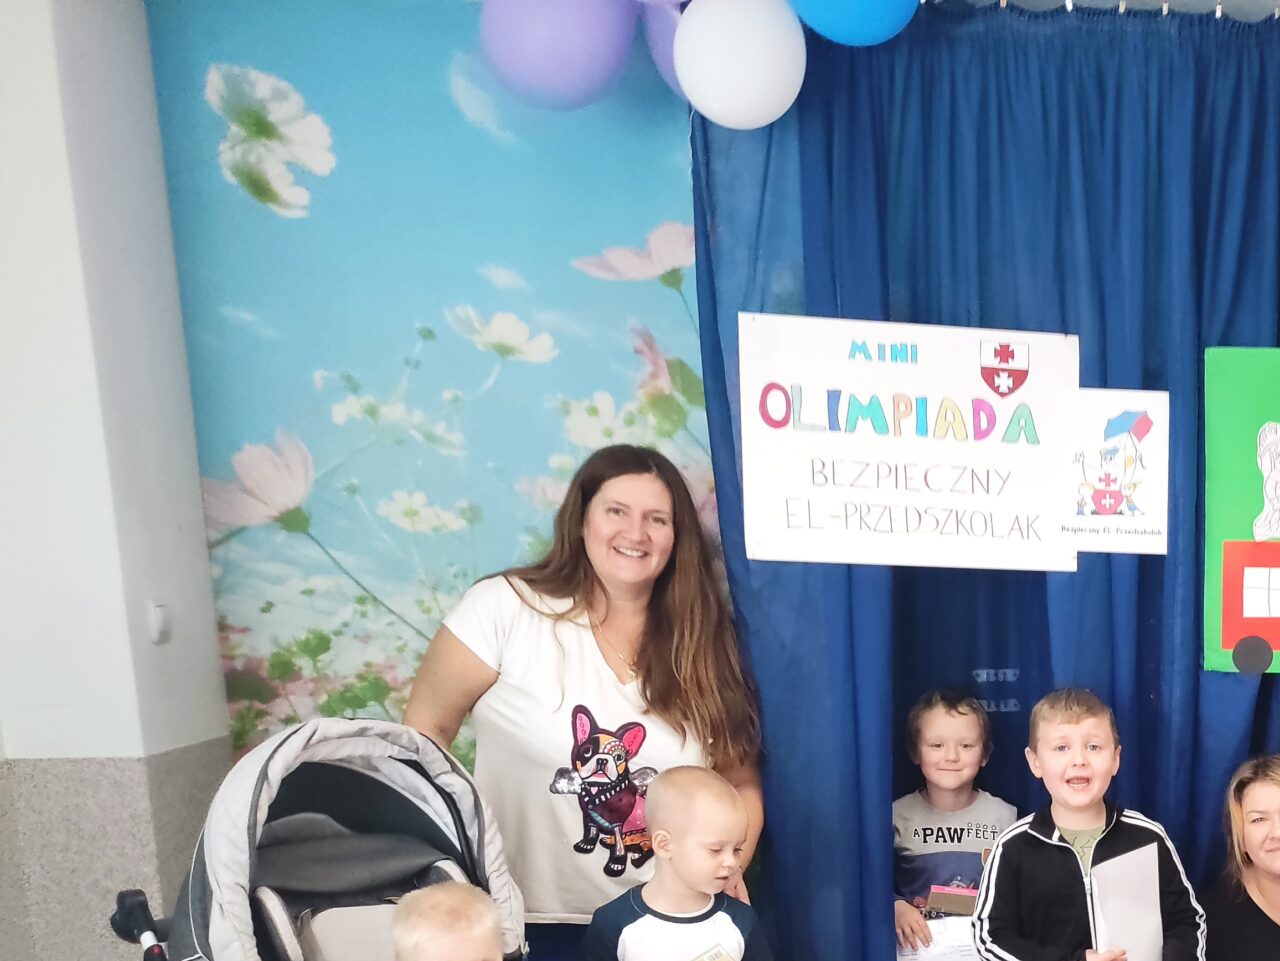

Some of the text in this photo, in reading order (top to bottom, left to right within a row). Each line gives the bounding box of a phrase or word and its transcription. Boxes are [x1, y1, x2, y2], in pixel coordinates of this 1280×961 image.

[848, 339, 918, 365] MINI
[758, 381, 1041, 446] OLIMPIADA
[810, 457, 1012, 498] BEZPIECZNY
